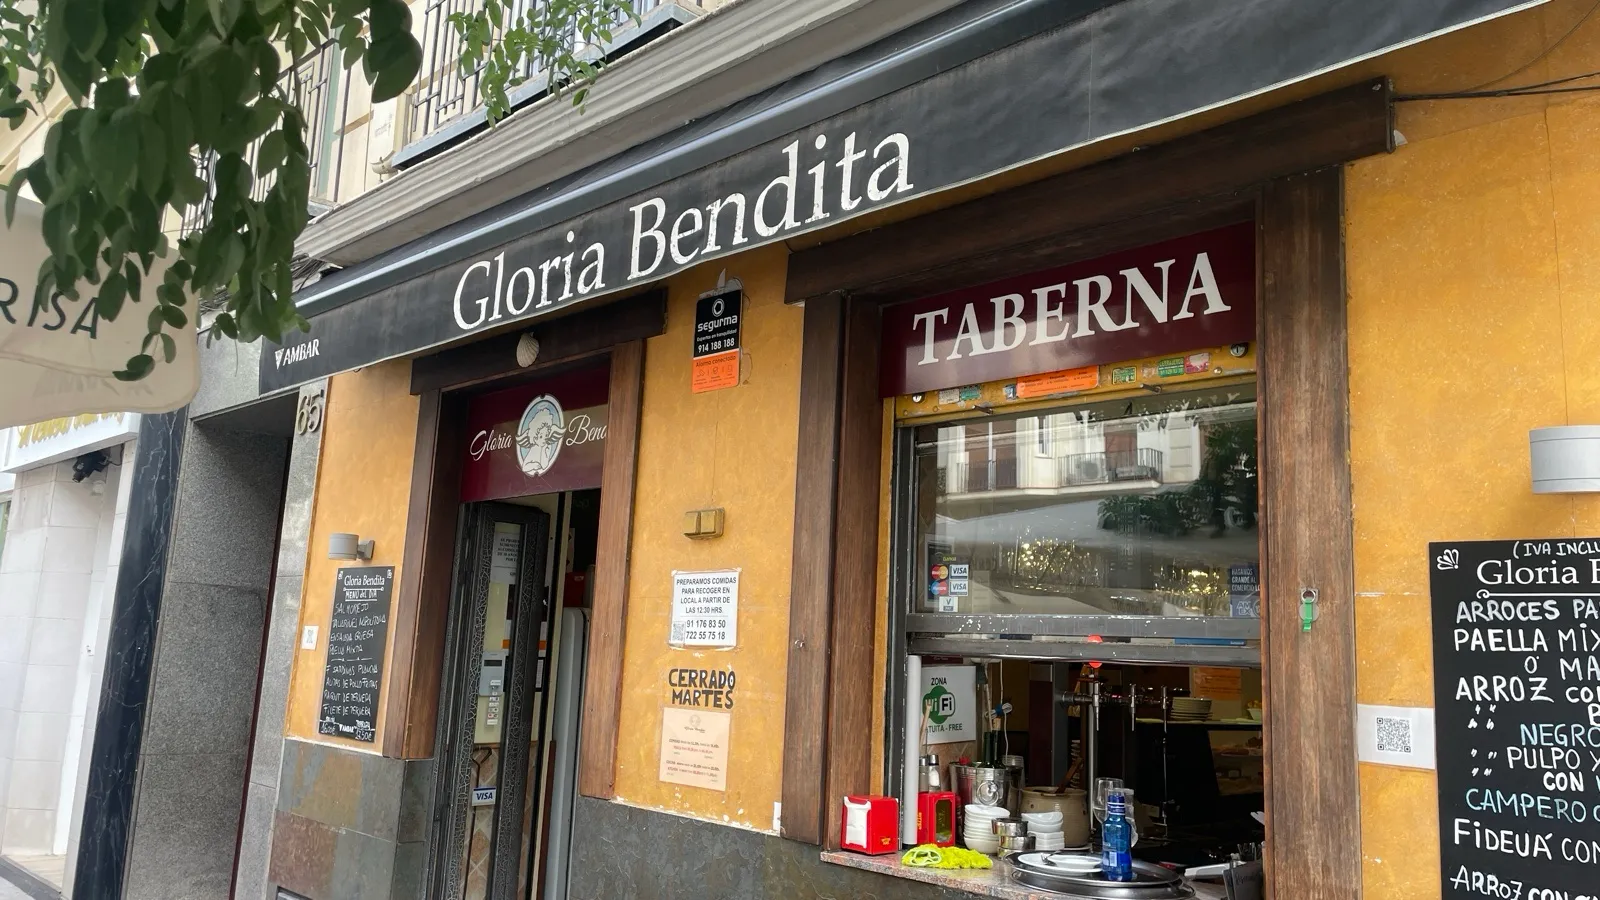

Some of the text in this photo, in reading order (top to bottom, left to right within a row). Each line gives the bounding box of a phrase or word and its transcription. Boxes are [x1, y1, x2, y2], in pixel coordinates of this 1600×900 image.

[453, 131, 913, 330] Gloria Bendita
[912, 251, 1232, 366] TABERNA
[697, 315, 738, 332] segurma
[283, 339, 320, 367] AMBAR
[698, 337, 735, 353] 914 188 188
[297, 390, 323, 435] 65
[470, 430, 512, 461] Gloria
[344, 574, 385, 586] Gloria Bendita
[953, 567, 967, 575] VISA
[1231, 576, 1249, 584] GRANDE
[1476, 559, 1579, 585] Gloria
[676, 578, 711, 586] PREPARAMOS
[1456, 599, 1560, 624] ARROCES
[686, 620, 726, 628] 91 176 83 50
[685, 631, 726, 640] 722 55 75 18
[1454, 628, 1548, 652] PAELLA
[668, 668, 736, 690] CERRADO
[931, 677, 947, 686] ZONA
[1455, 675, 1600, 704] ARROZ CO
[672, 689, 734, 709] MARTES
[948, 723, 963, 731] FREE
[1506, 746, 1581, 769] PULPO
[1543, 771, 1584, 792] CON
[476, 792, 493, 801] VISA
[1466, 788, 1587, 823] CAMPERO
